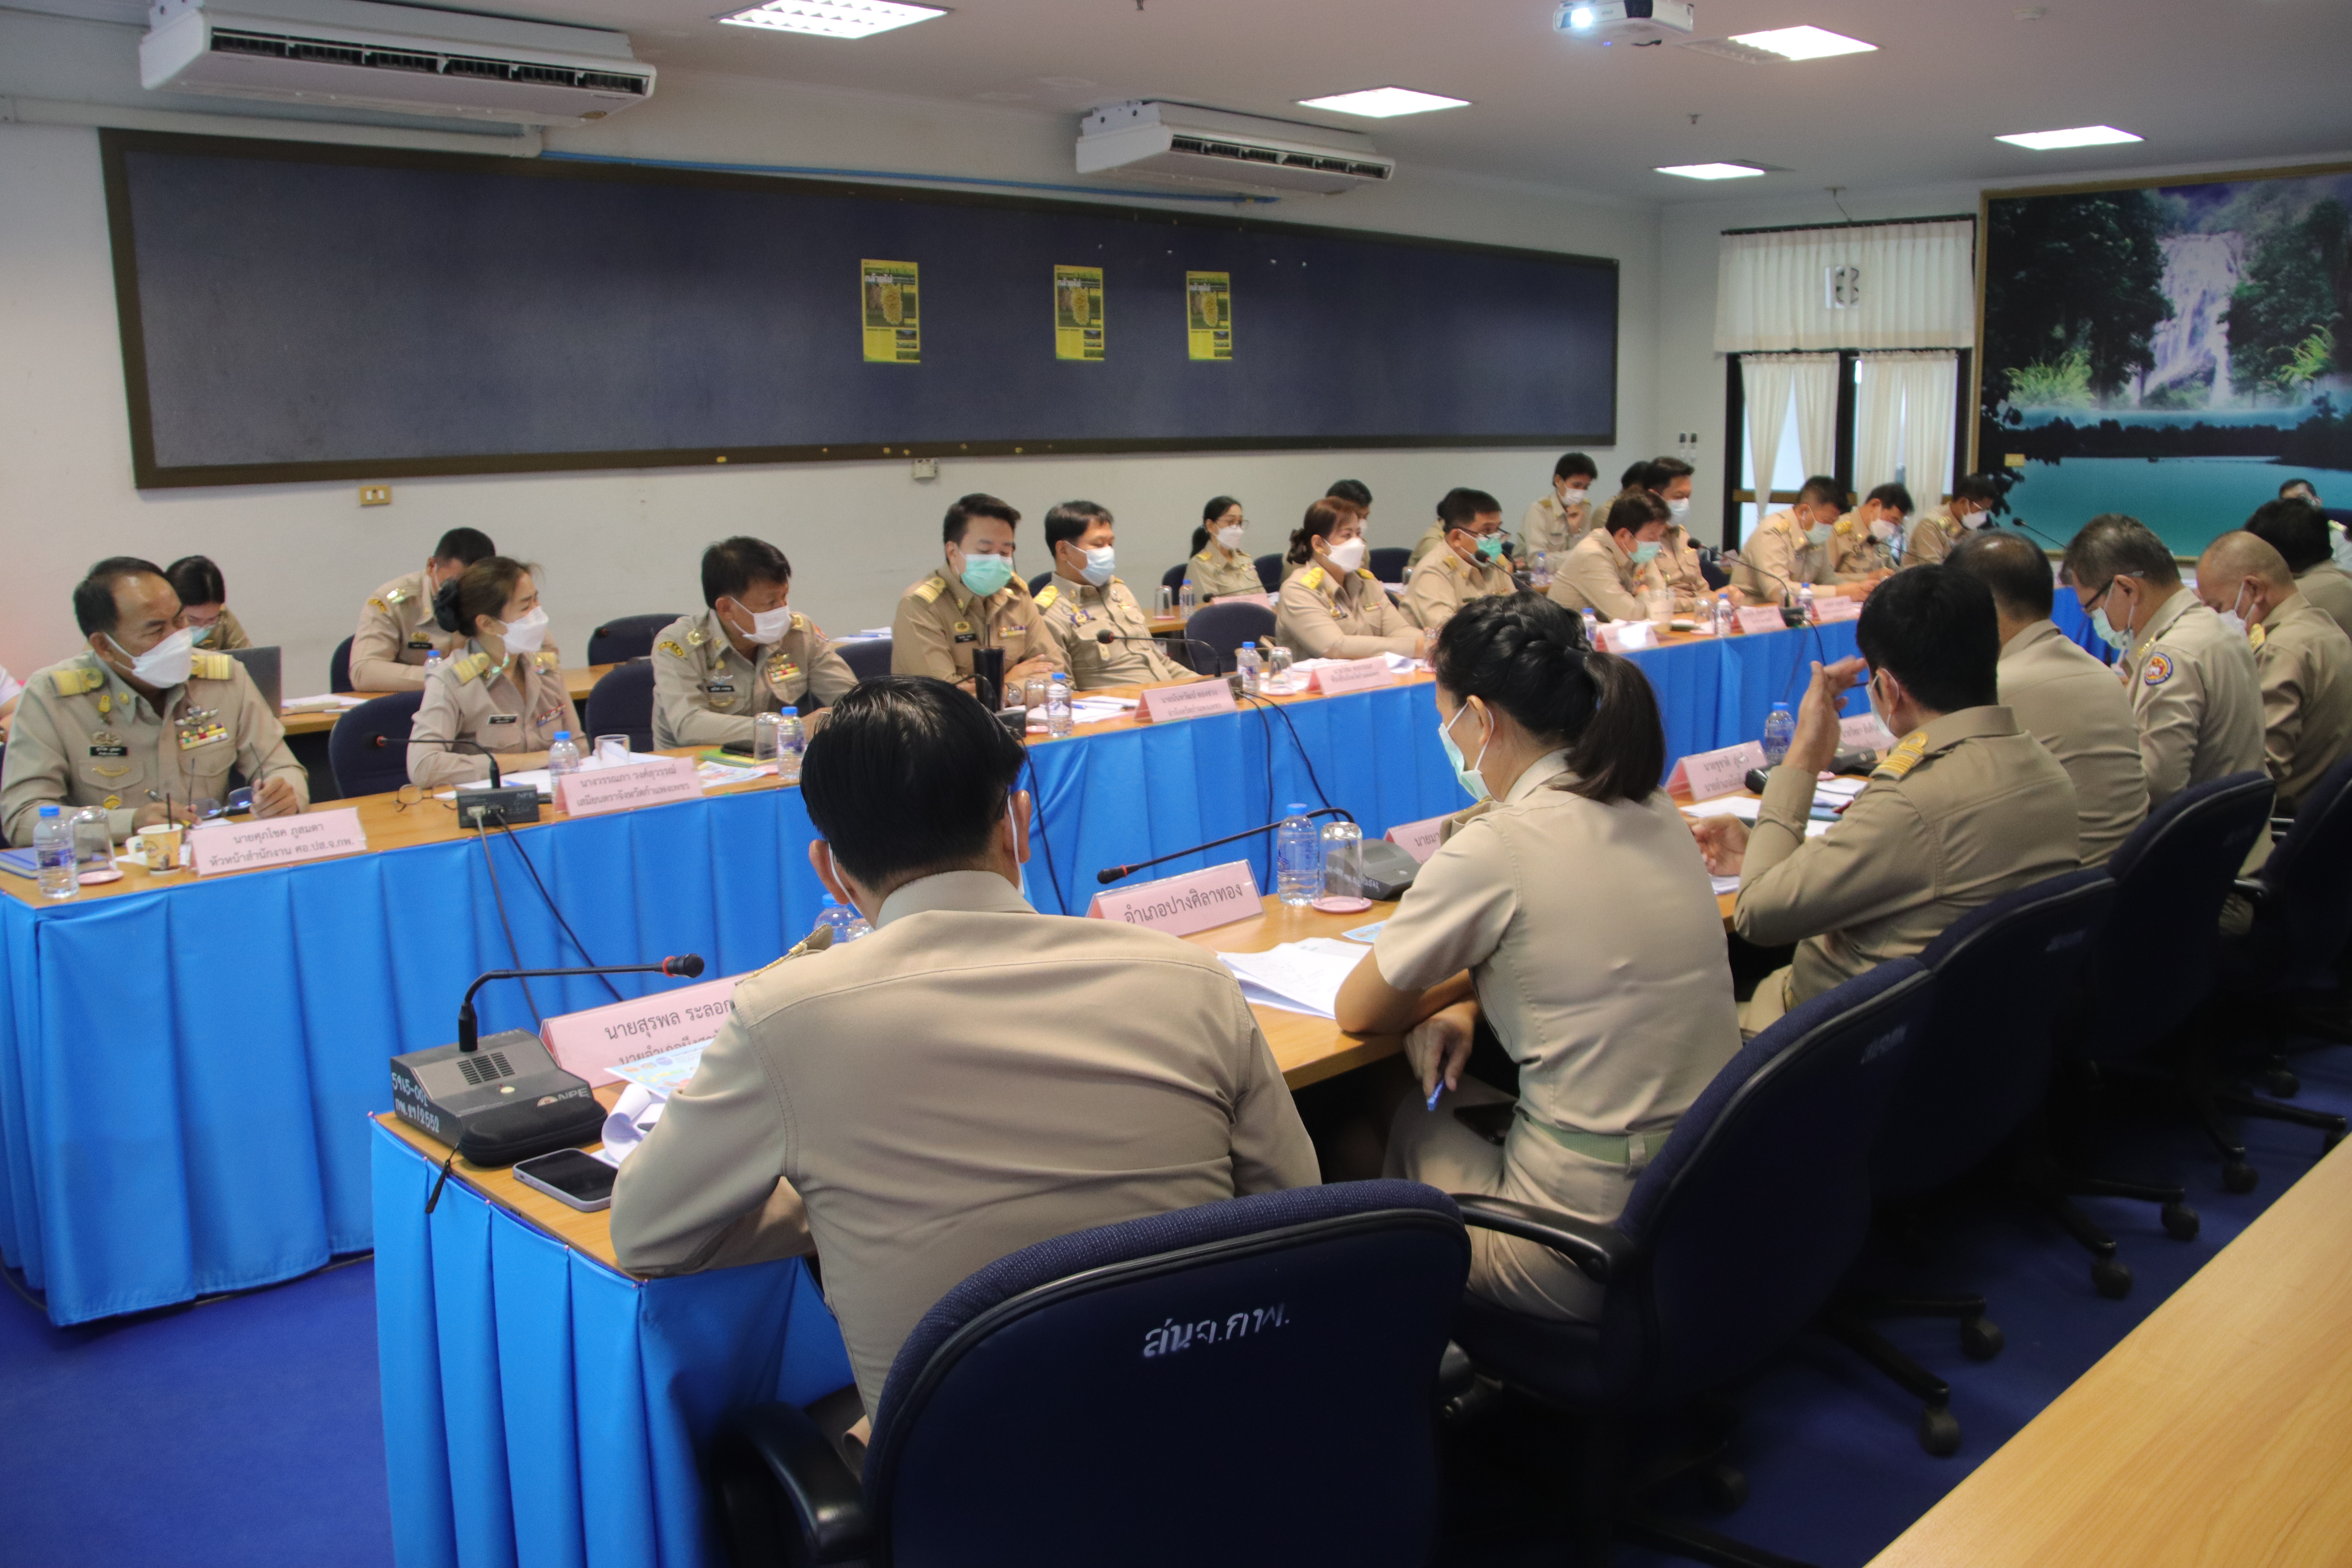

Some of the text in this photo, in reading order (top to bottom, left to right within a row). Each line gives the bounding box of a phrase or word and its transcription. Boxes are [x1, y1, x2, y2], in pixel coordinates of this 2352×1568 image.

[209, 847, 292, 867] หัวหน้าสำนักงาน
[1124, 884, 1243, 924] อำเภอปางศิลาทอง
[604, 1011, 681, 1040] นายสุรพล
